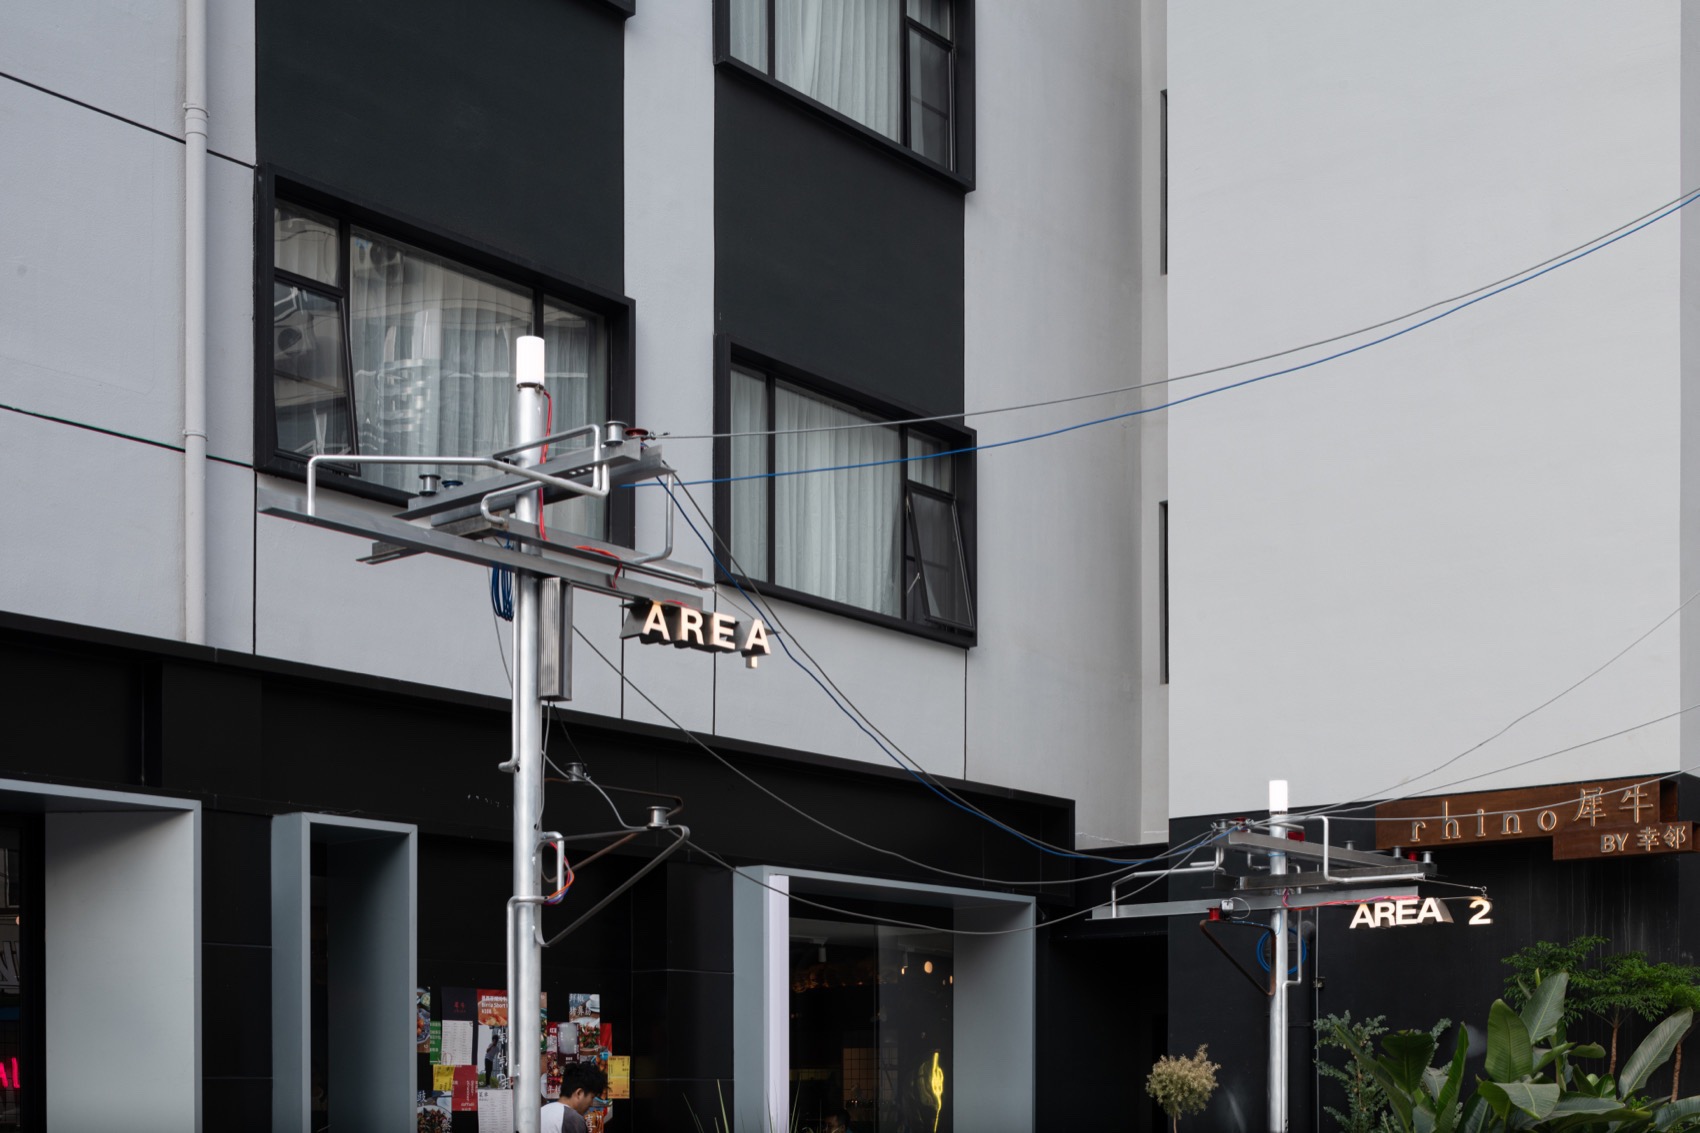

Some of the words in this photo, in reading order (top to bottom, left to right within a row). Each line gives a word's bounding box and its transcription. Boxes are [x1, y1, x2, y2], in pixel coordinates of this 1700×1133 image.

[642, 601, 771, 655] AREA
[1410, 800, 1558, 842] rhino
[1572, 784, 1654, 827] 犀牛
[1601, 833, 1629, 853] BY
[1637, 825, 1686, 851] 幸邻
[1349, 897, 1444, 929] AREA
[1468, 898, 1493, 925] 2
